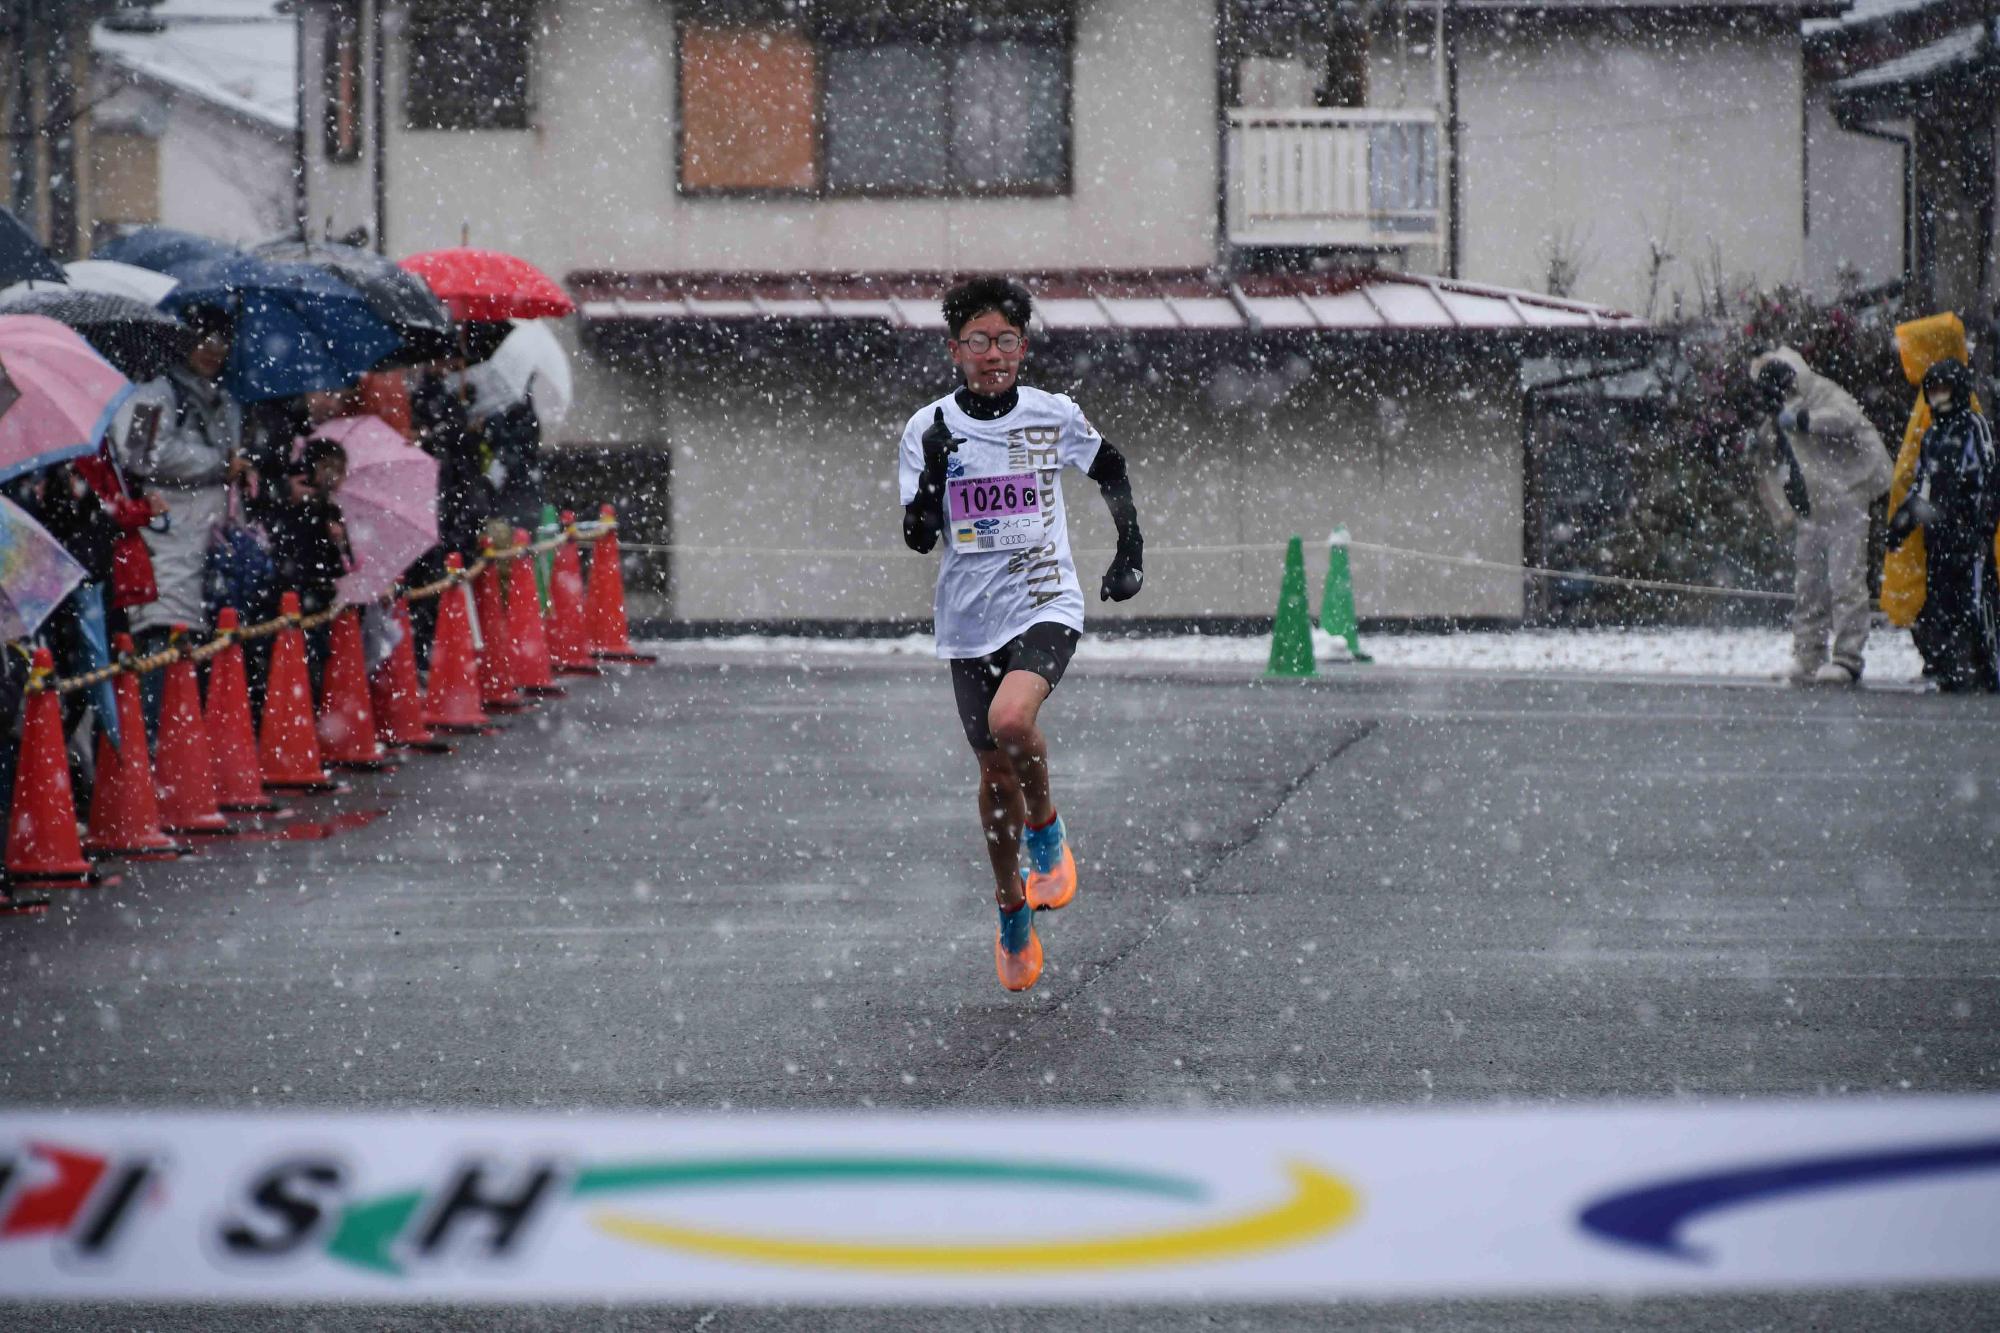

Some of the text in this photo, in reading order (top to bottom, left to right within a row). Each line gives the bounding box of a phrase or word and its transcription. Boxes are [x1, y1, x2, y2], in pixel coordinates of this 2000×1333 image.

[960, 484, 1017, 513] 1026
[1003, 519, 1040, 530] メイコー
